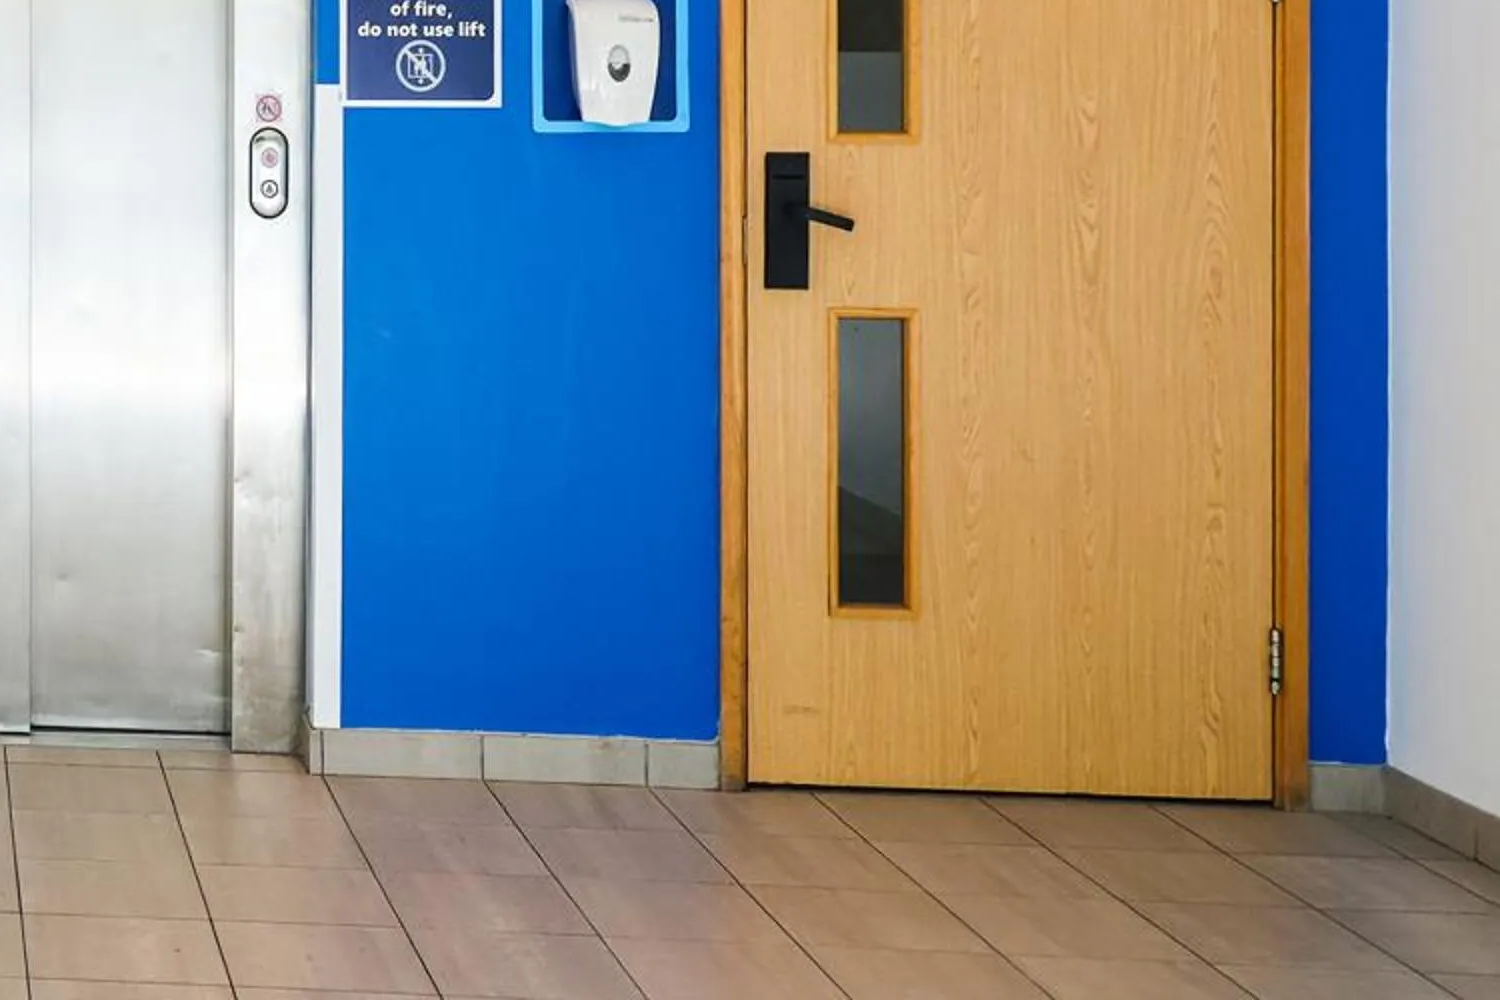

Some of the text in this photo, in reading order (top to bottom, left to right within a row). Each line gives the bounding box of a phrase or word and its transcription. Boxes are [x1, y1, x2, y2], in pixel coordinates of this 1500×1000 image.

[390, 0, 453, 20] of fire,
[357, 21, 486, 37] do not use lift
